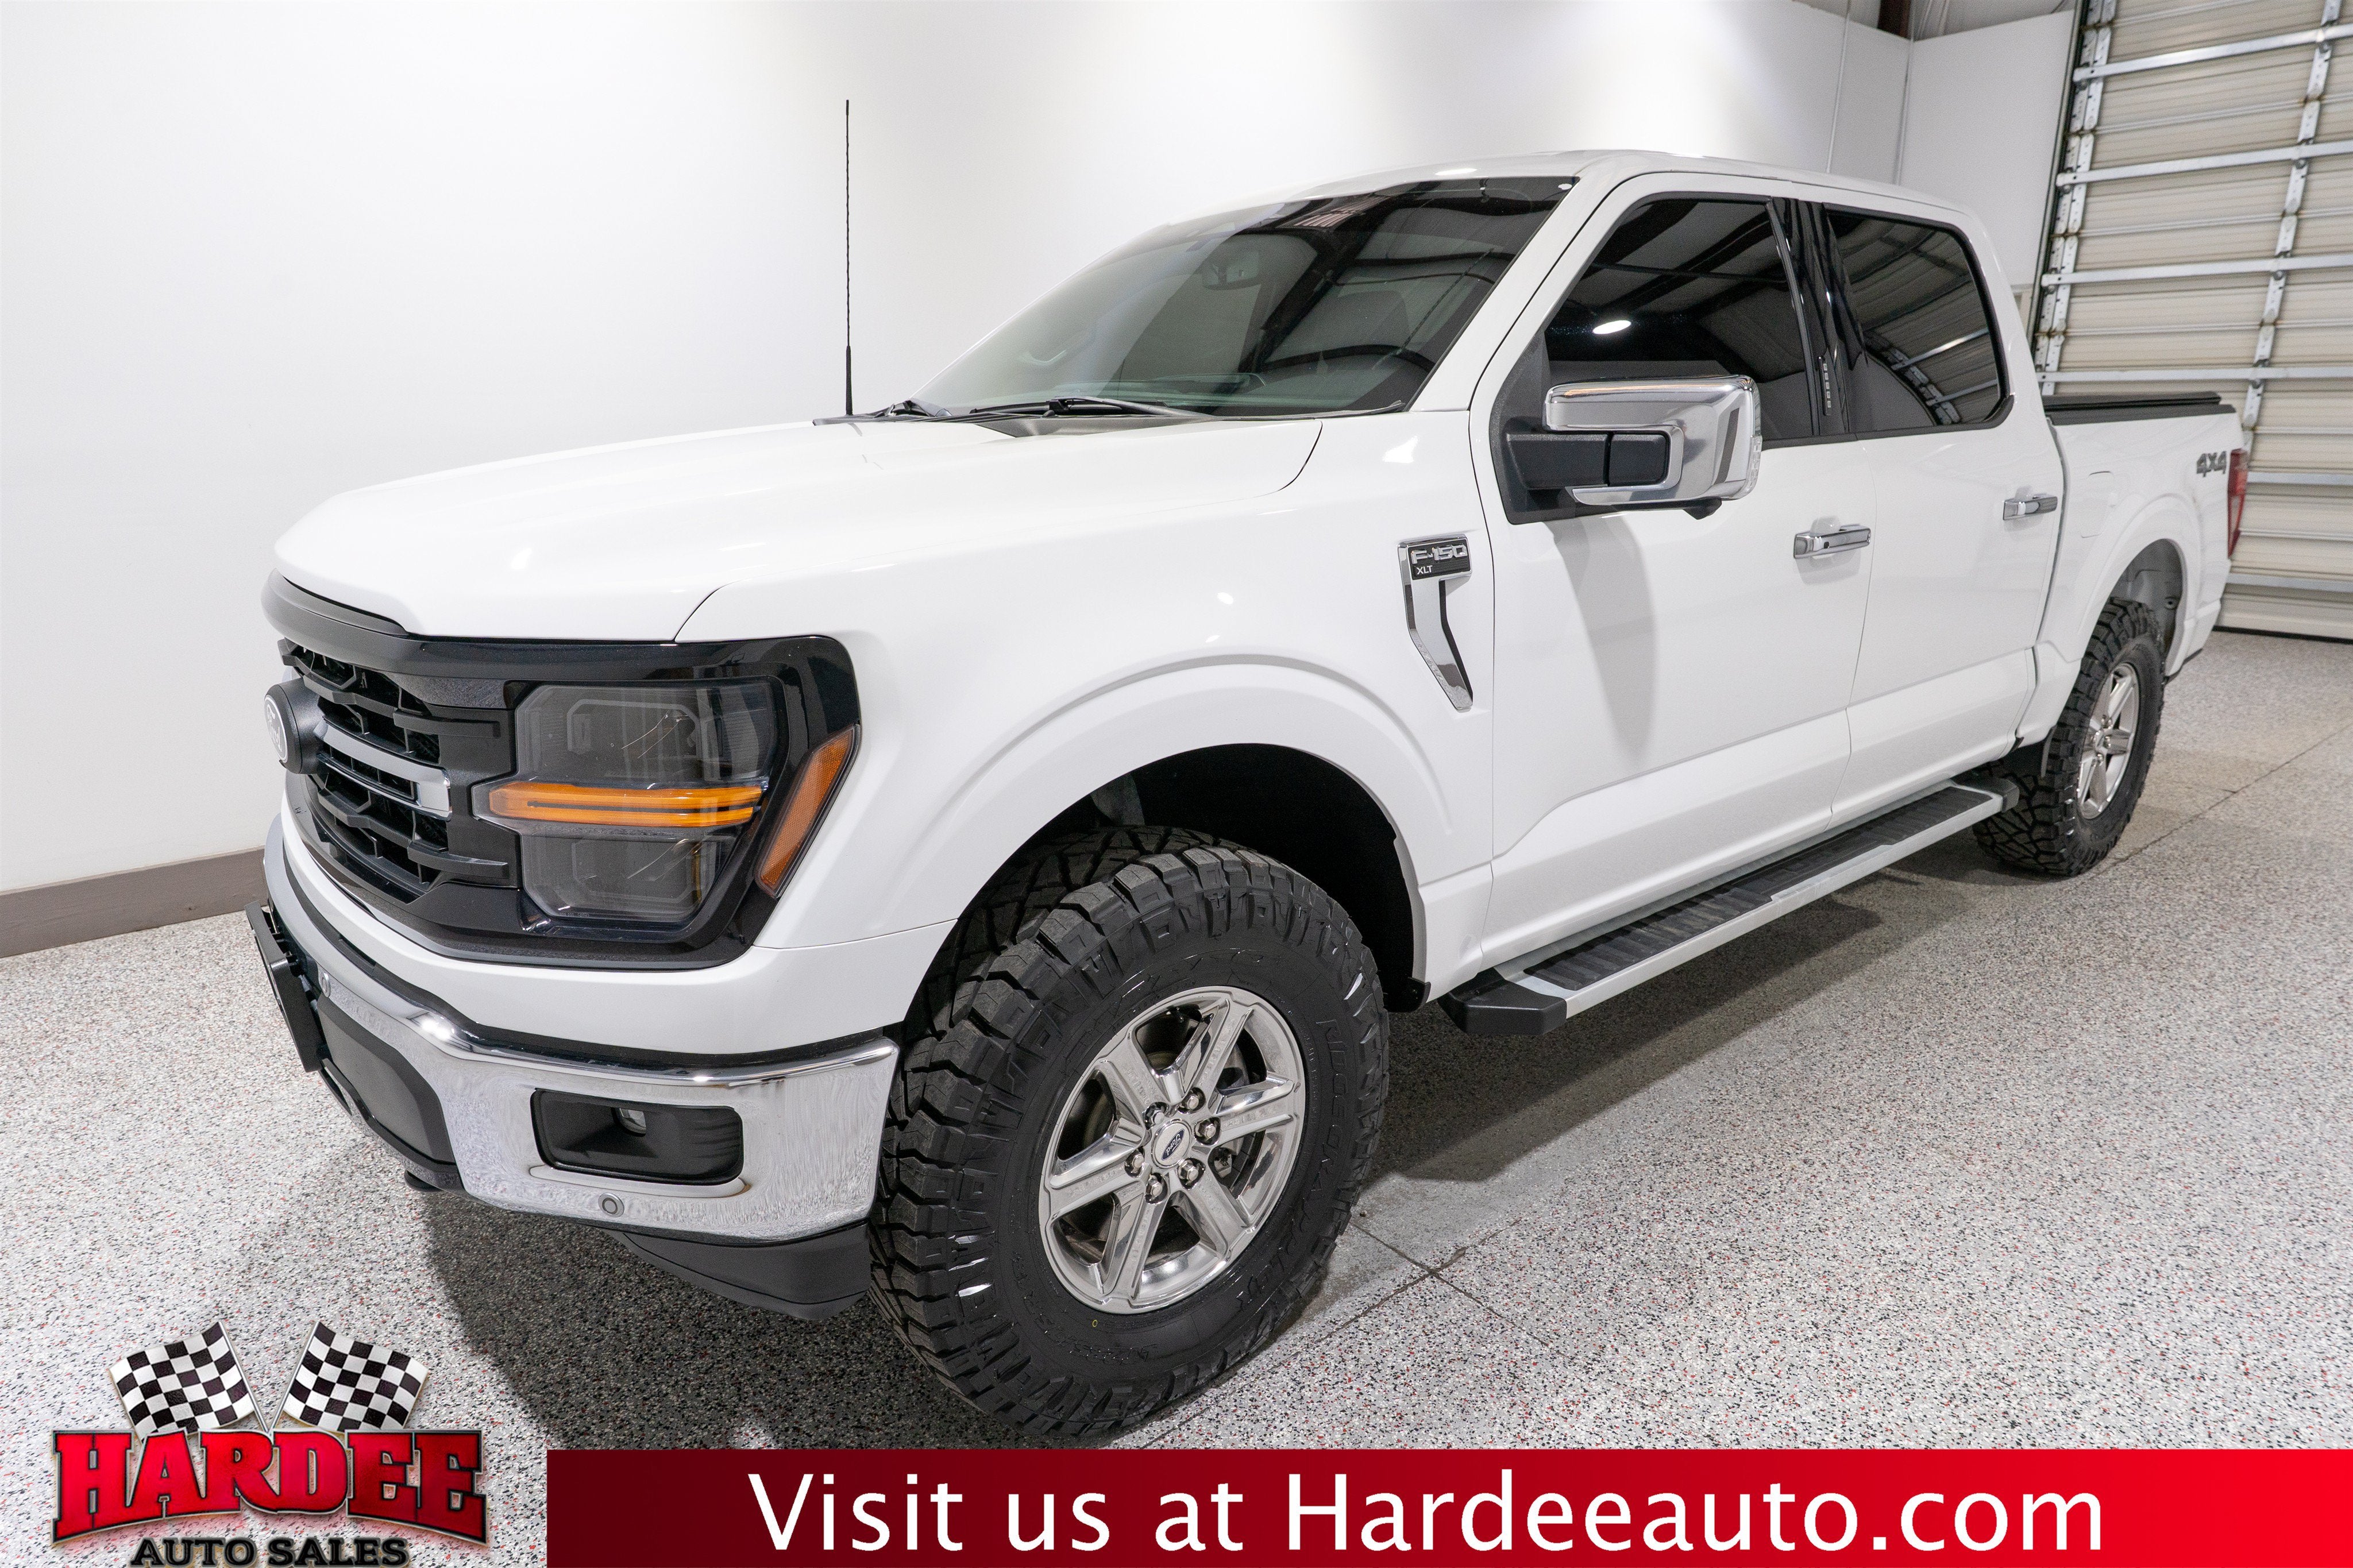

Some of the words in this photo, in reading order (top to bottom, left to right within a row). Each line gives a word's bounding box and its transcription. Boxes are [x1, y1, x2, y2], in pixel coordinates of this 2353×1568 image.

[1411, 543, 1468, 564] F-150
[1416, 565, 1433, 575] XLT
[266, 704, 283, 752] Ford
[1166, 1133, 1182, 1156] Ford
